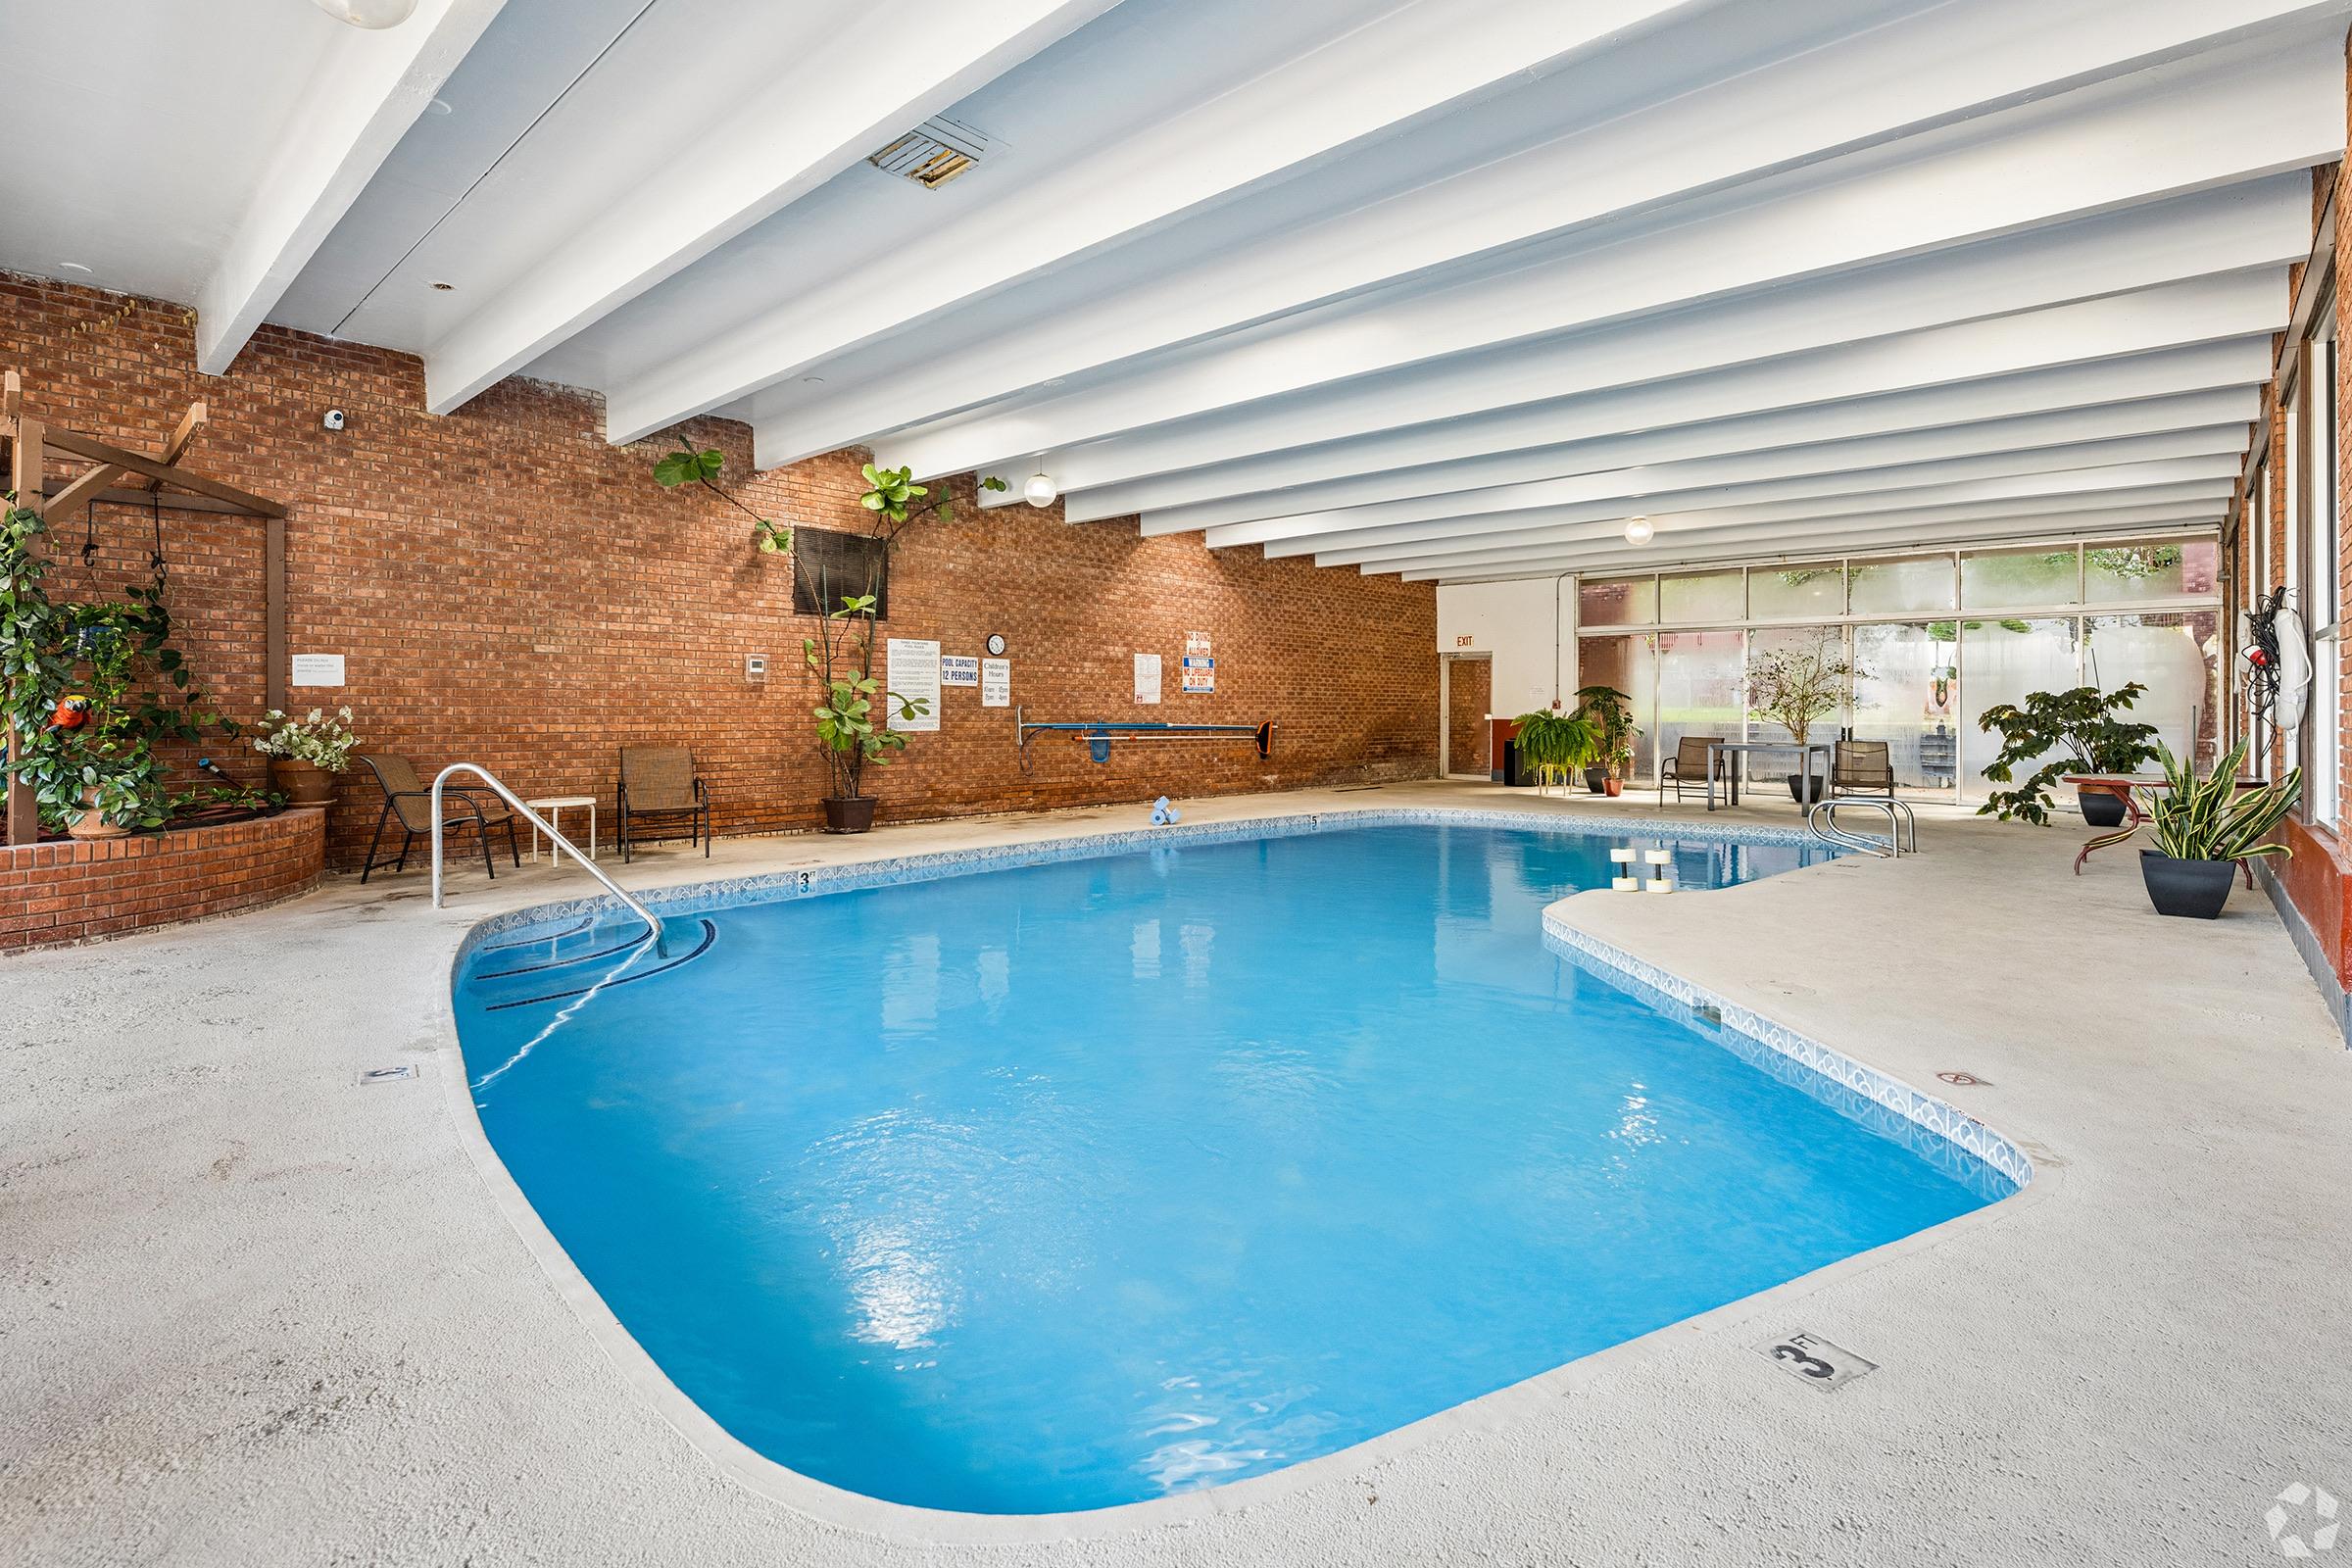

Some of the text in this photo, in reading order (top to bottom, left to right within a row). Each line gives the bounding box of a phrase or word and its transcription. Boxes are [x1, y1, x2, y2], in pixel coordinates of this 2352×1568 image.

[1186, 632, 1210, 642] NO DIVING
[1457, 636, 1473, 647] EXIT
[1189, 647, 1208, 656] ALLOWED
[942, 658, 978, 667] POOL CAPACITY
[942, 670, 978, 681] 12 PERSONS
[1183, 667, 1213, 677] NO LIFEGUARD
[1189, 677, 1207, 686] ON DUTY
[800, 872, 809, 885] 3
[1770, 1334, 1836, 1379] 3 FT
